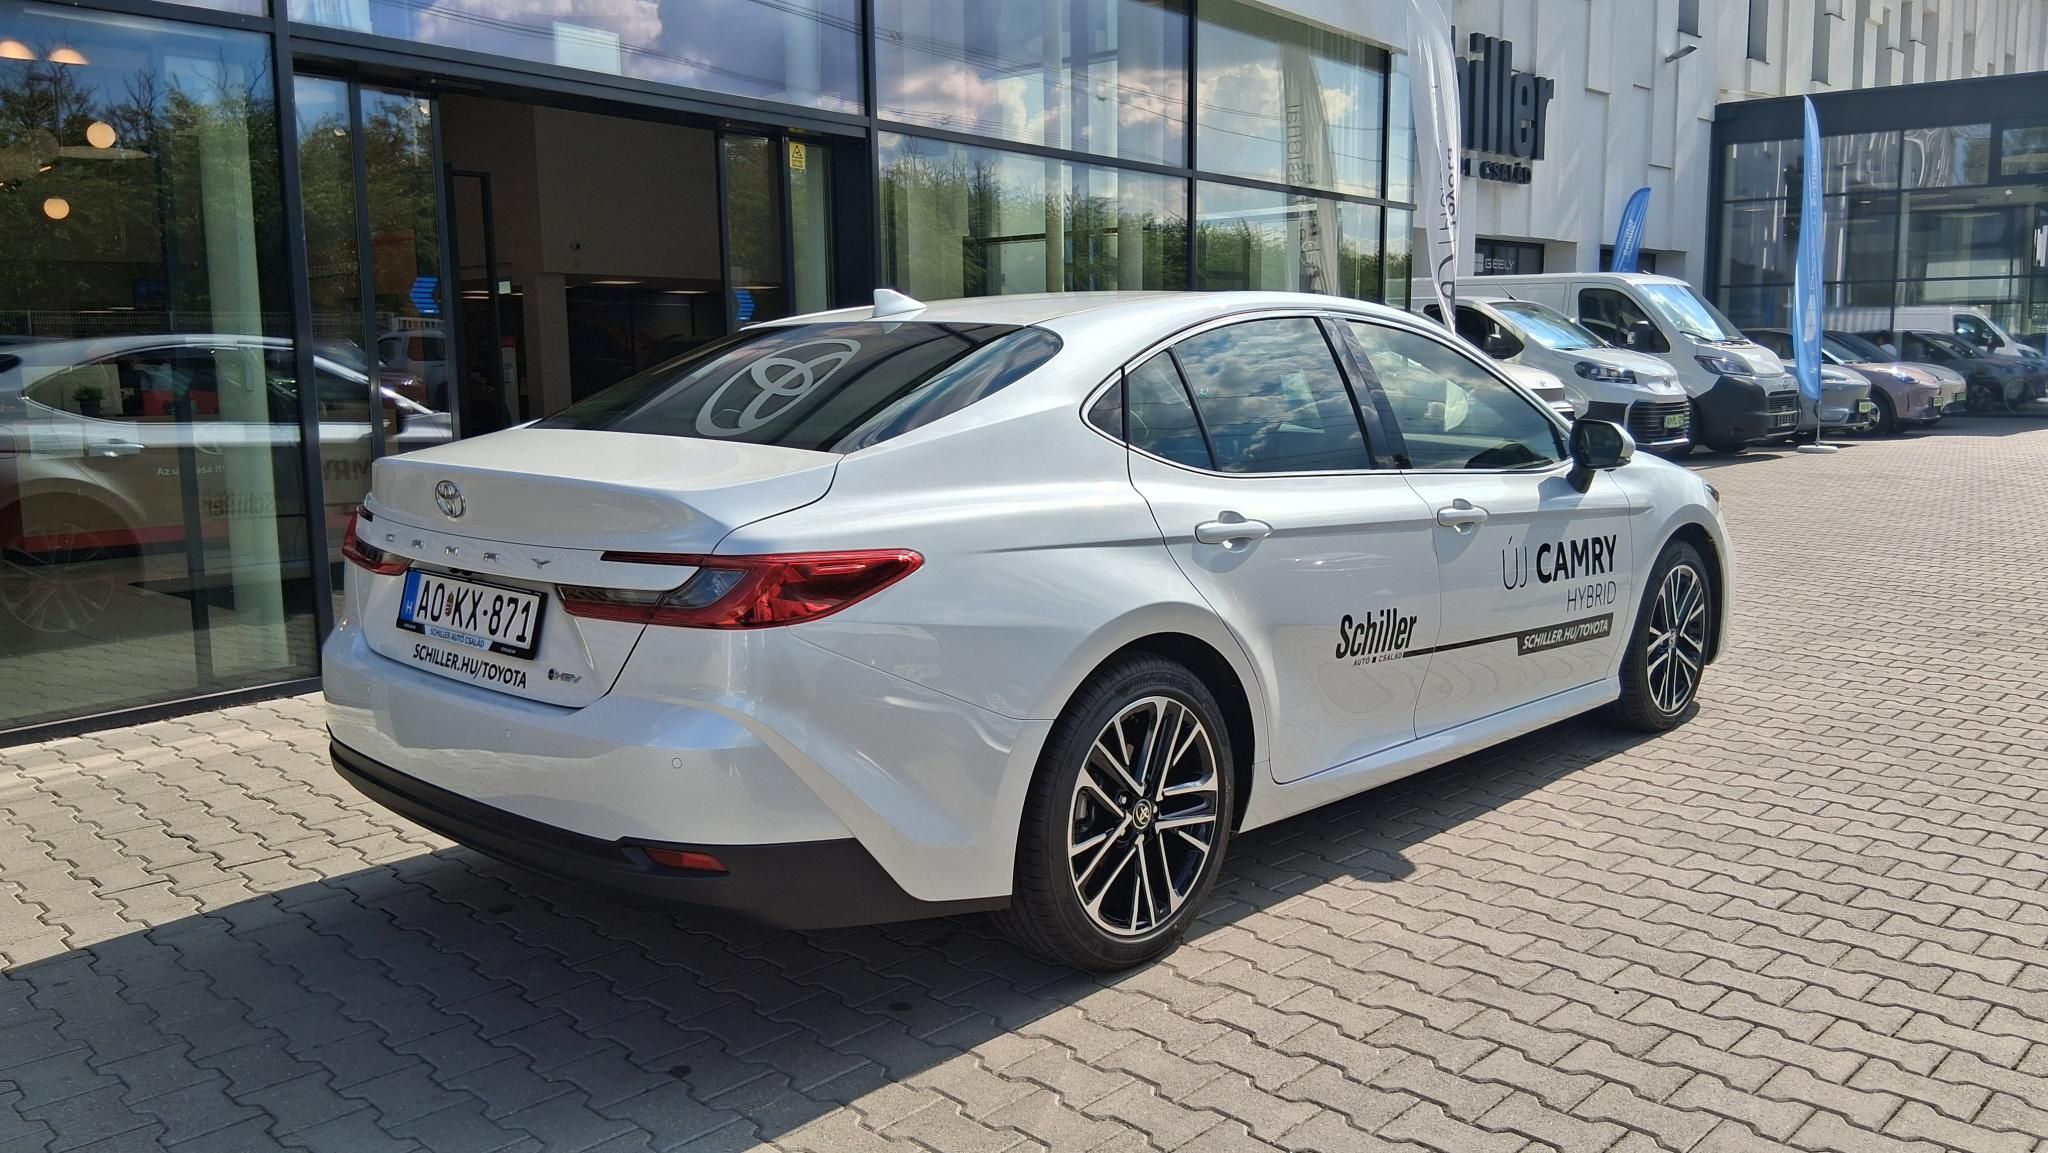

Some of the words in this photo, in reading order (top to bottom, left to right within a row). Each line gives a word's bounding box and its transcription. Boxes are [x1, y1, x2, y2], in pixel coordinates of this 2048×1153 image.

[1485, 258, 1515, 270] GEELY
[385, 533, 551, 569] CAMRY
[1502, 536, 1529, 591] ÚJ
[1536, 534, 1617, 584] CAMRY
[406, 601, 414, 615] H
[1566, 581, 1618, 613] HYBRID
[1336, 608, 1418, 659] Schiller
[1522, 622, 1609, 651] SCHILLER.HU/TOYOTA
[413, 643, 528, 690] SCHILLER.HU/TOYOTA
